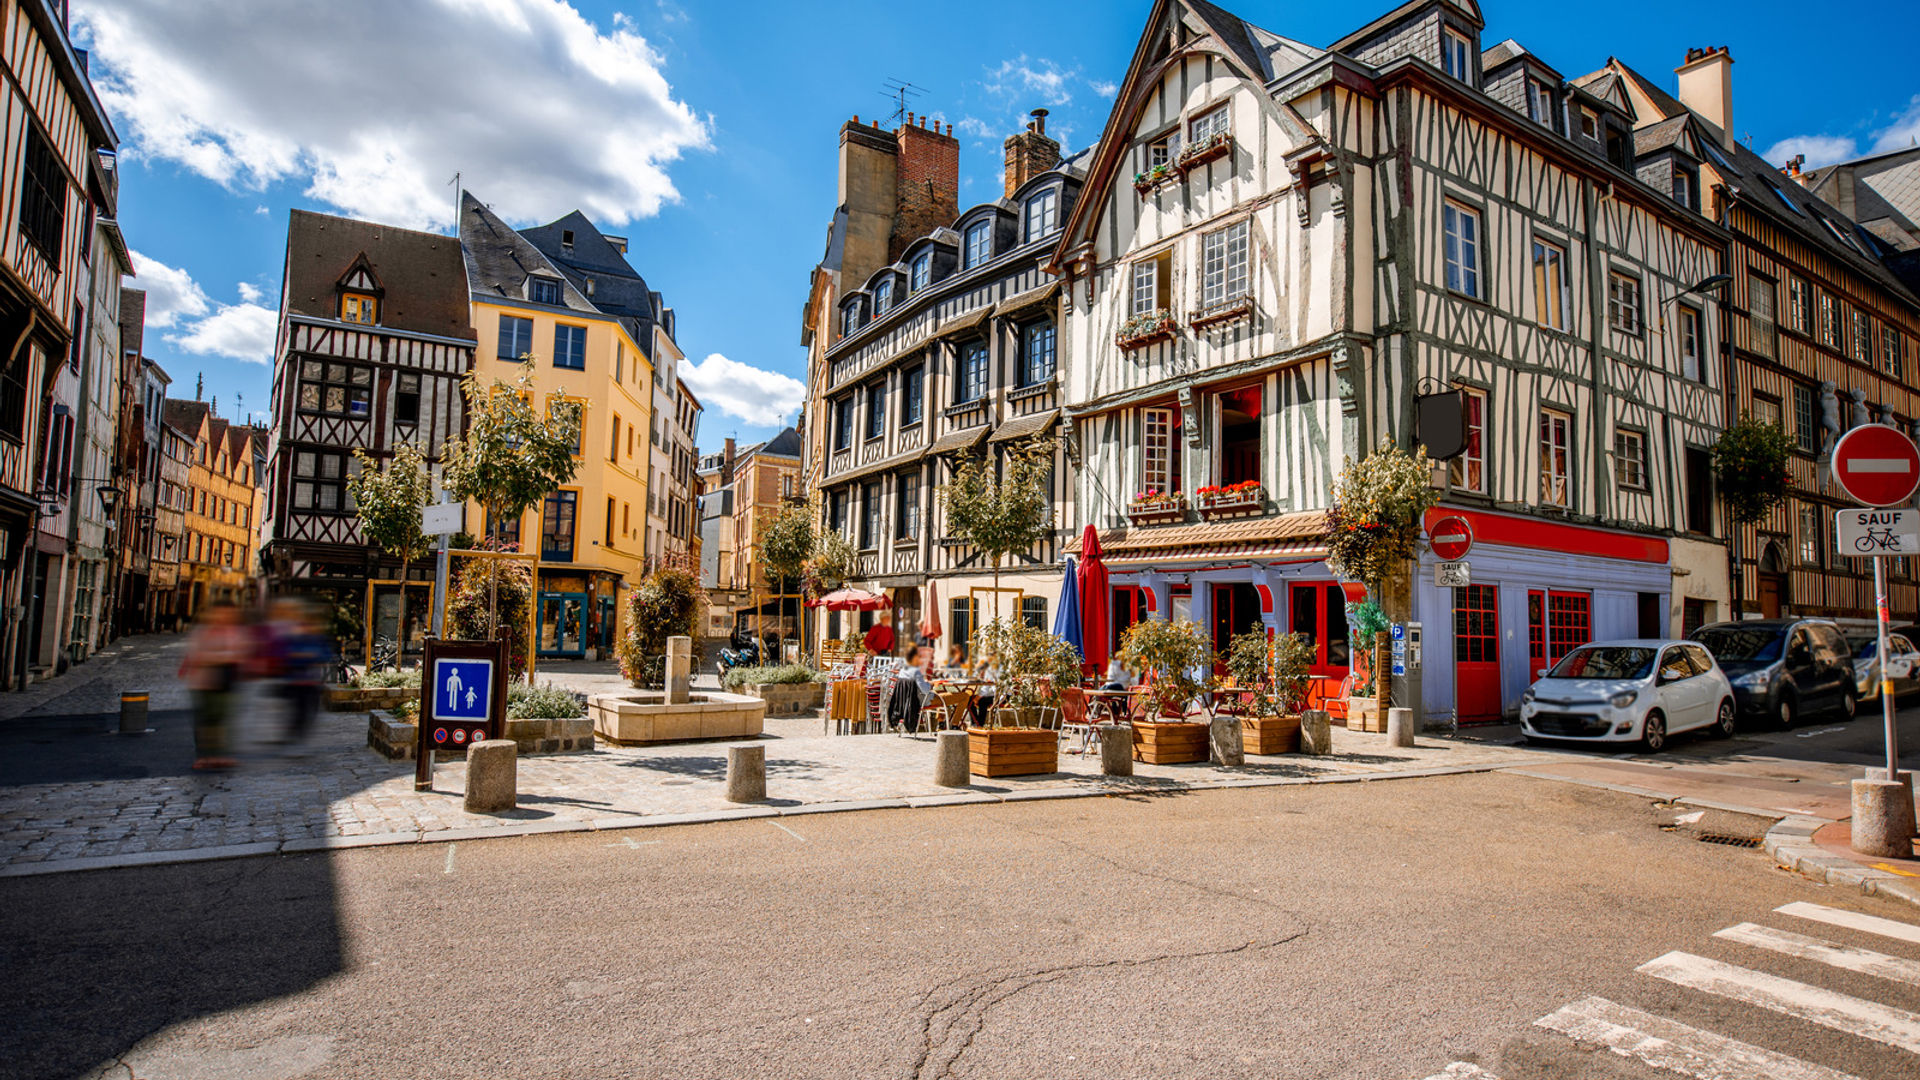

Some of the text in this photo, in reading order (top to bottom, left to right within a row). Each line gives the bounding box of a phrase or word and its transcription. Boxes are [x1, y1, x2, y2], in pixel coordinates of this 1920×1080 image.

[1858, 513, 1902, 525] SAUF
[1441, 563, 1461, 571] SAUF
[1394, 627, 1401, 637] P
